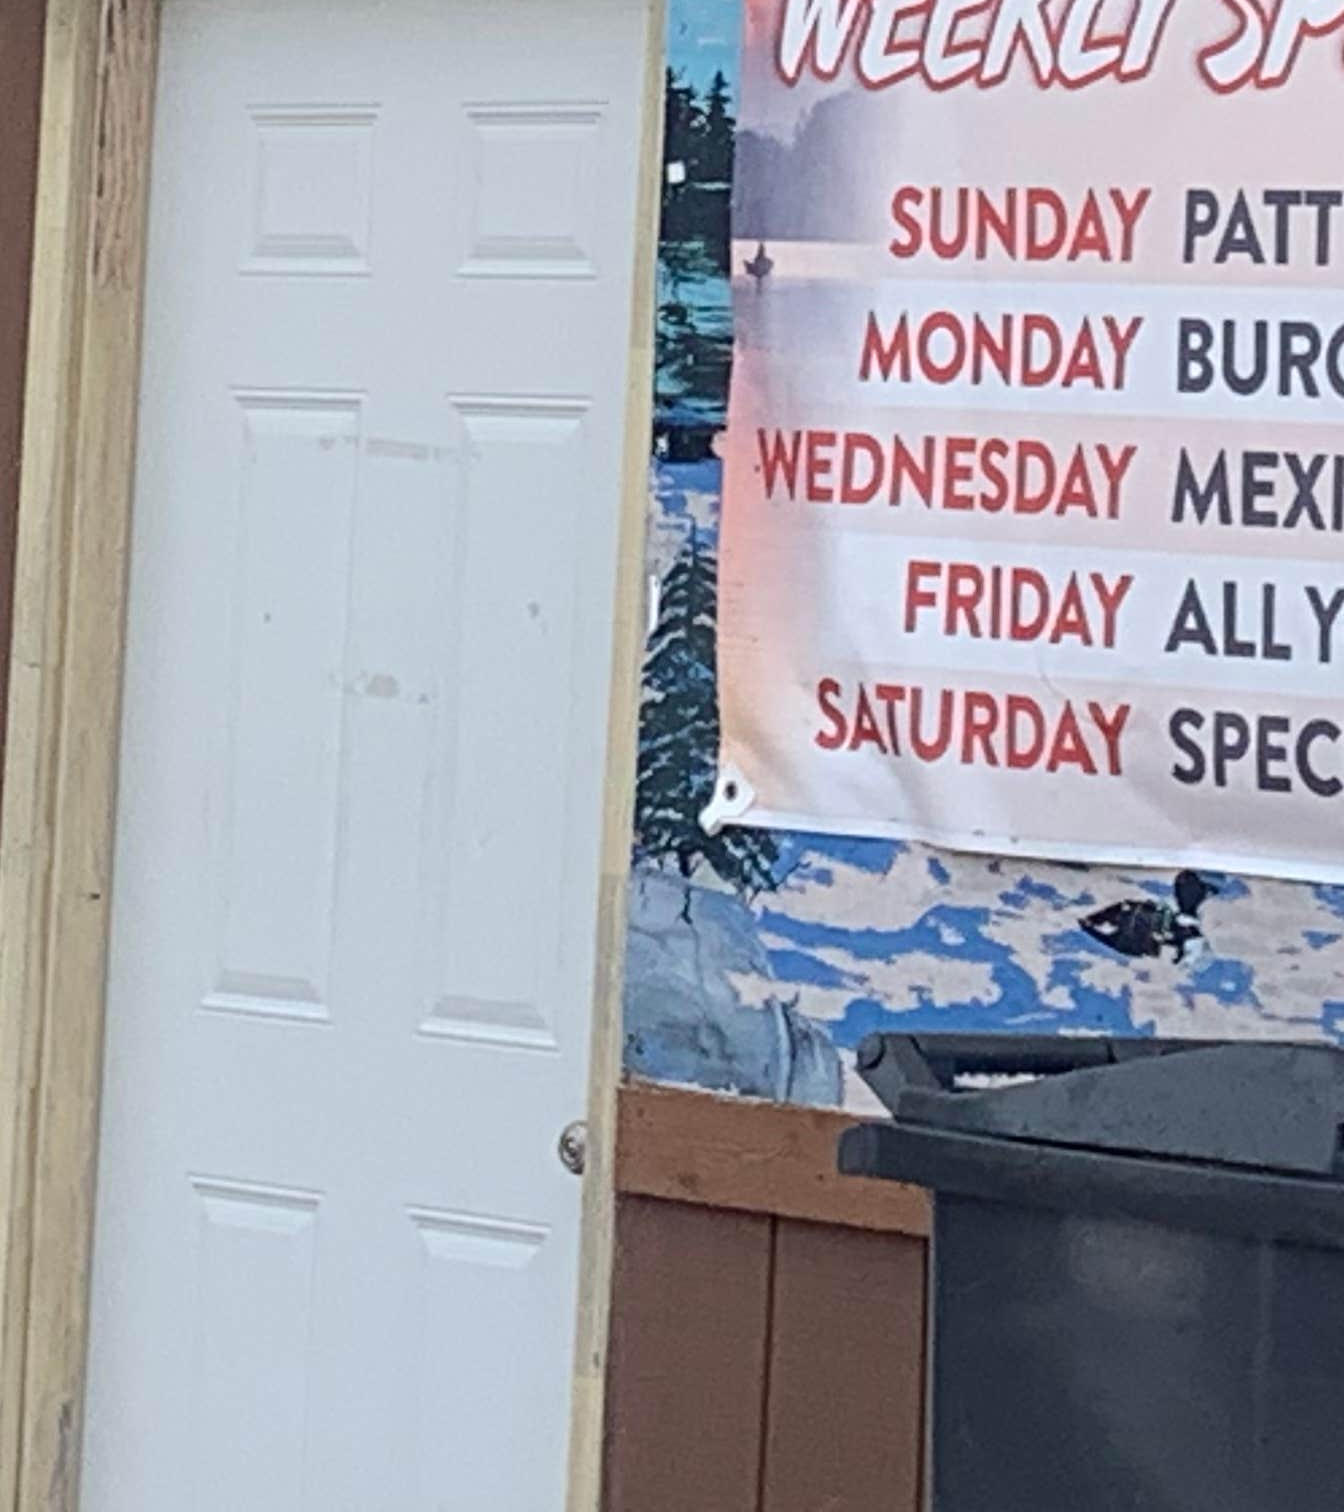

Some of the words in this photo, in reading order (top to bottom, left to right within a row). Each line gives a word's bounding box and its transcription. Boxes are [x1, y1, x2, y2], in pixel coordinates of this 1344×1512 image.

[890, 187, 1152, 263] SUNDAY
[858, 311, 1144, 389] MONDAY
[760, 429, 1137, 520] WEDNESDAY
[903, 561, 1134, 649] FRIDAY
[1166, 577, 1295, 664] ALL
[815, 678, 1132, 778] SATURDAY
